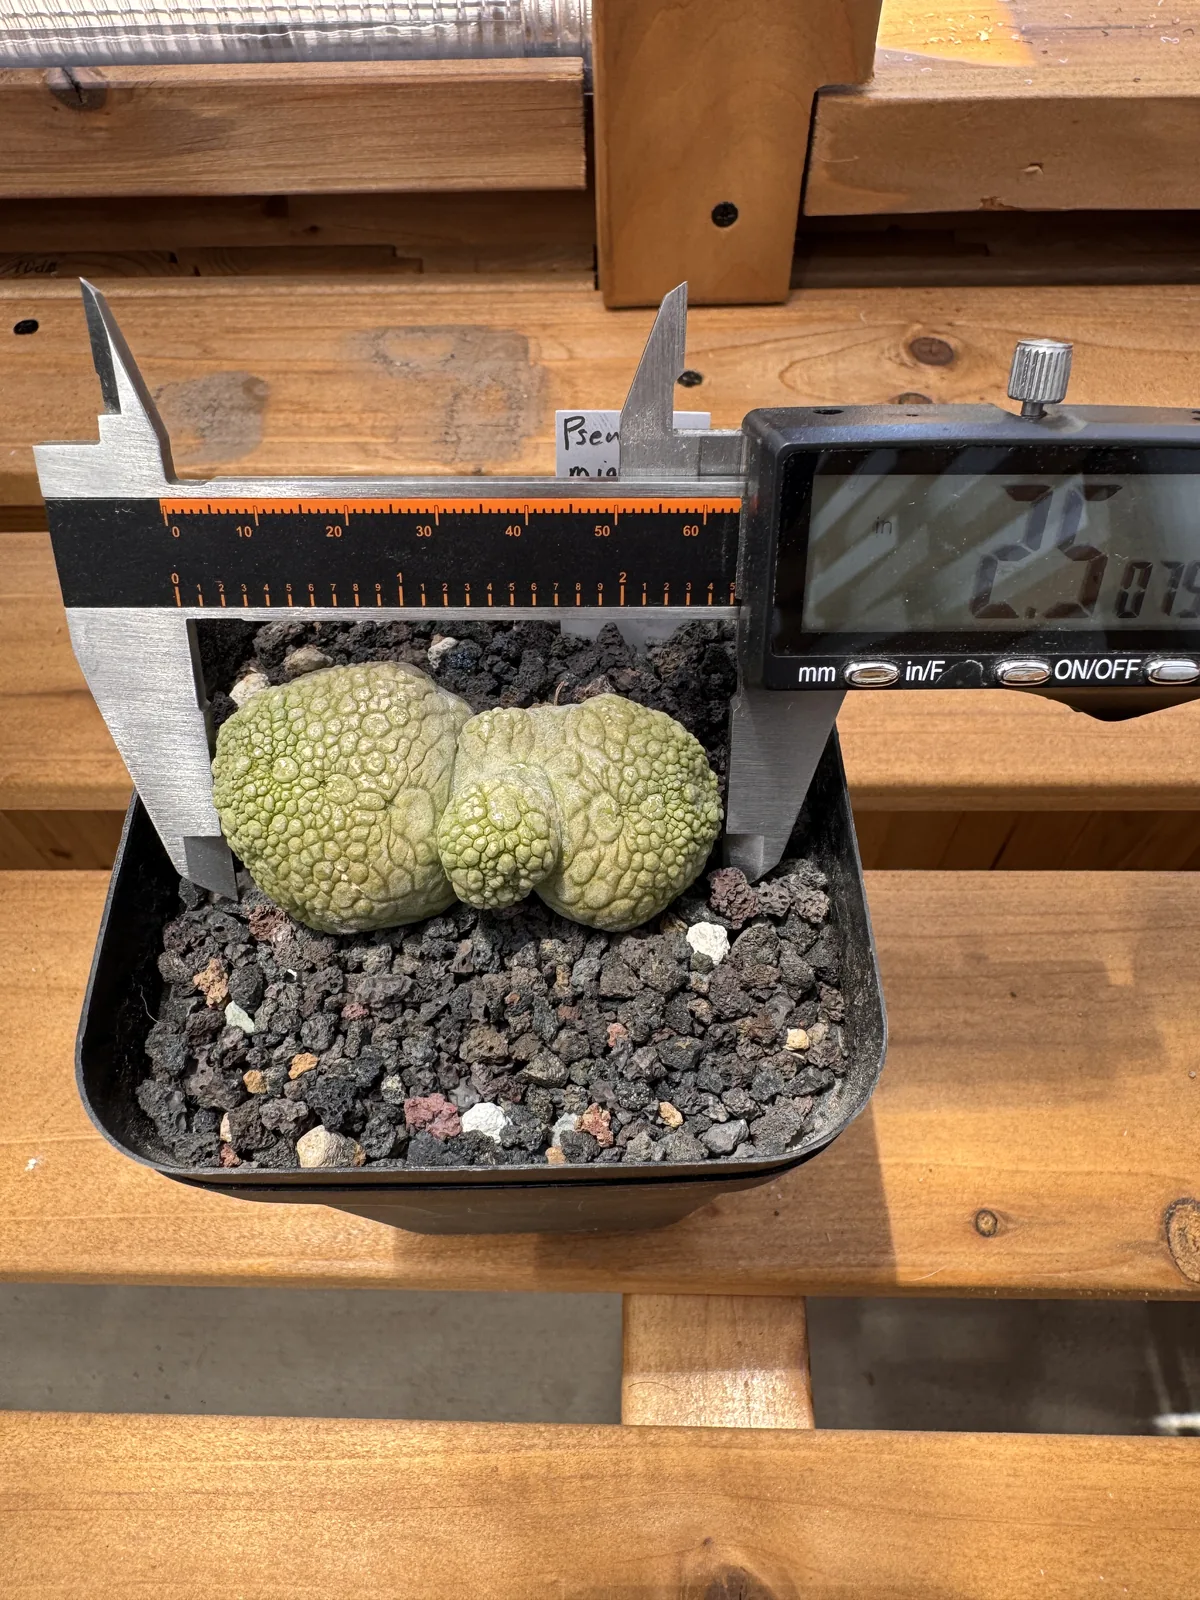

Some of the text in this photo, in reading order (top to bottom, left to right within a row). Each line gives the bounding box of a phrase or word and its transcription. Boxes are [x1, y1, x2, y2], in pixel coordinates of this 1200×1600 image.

[171, 525, 700, 538] 0 10 20 30 40 50 60
[875, 515, 893, 535] in
[170, 571, 736, 592] 0 1 2 3 4 5 6 7 8 9 1 1 2 3 4 5 6 7 8 9 2 1 2 3 4 5
[798, 666, 836, 683] mm
[904, 659, 945, 682] in/F
[1053, 657, 1142, 681] ON/OFF
